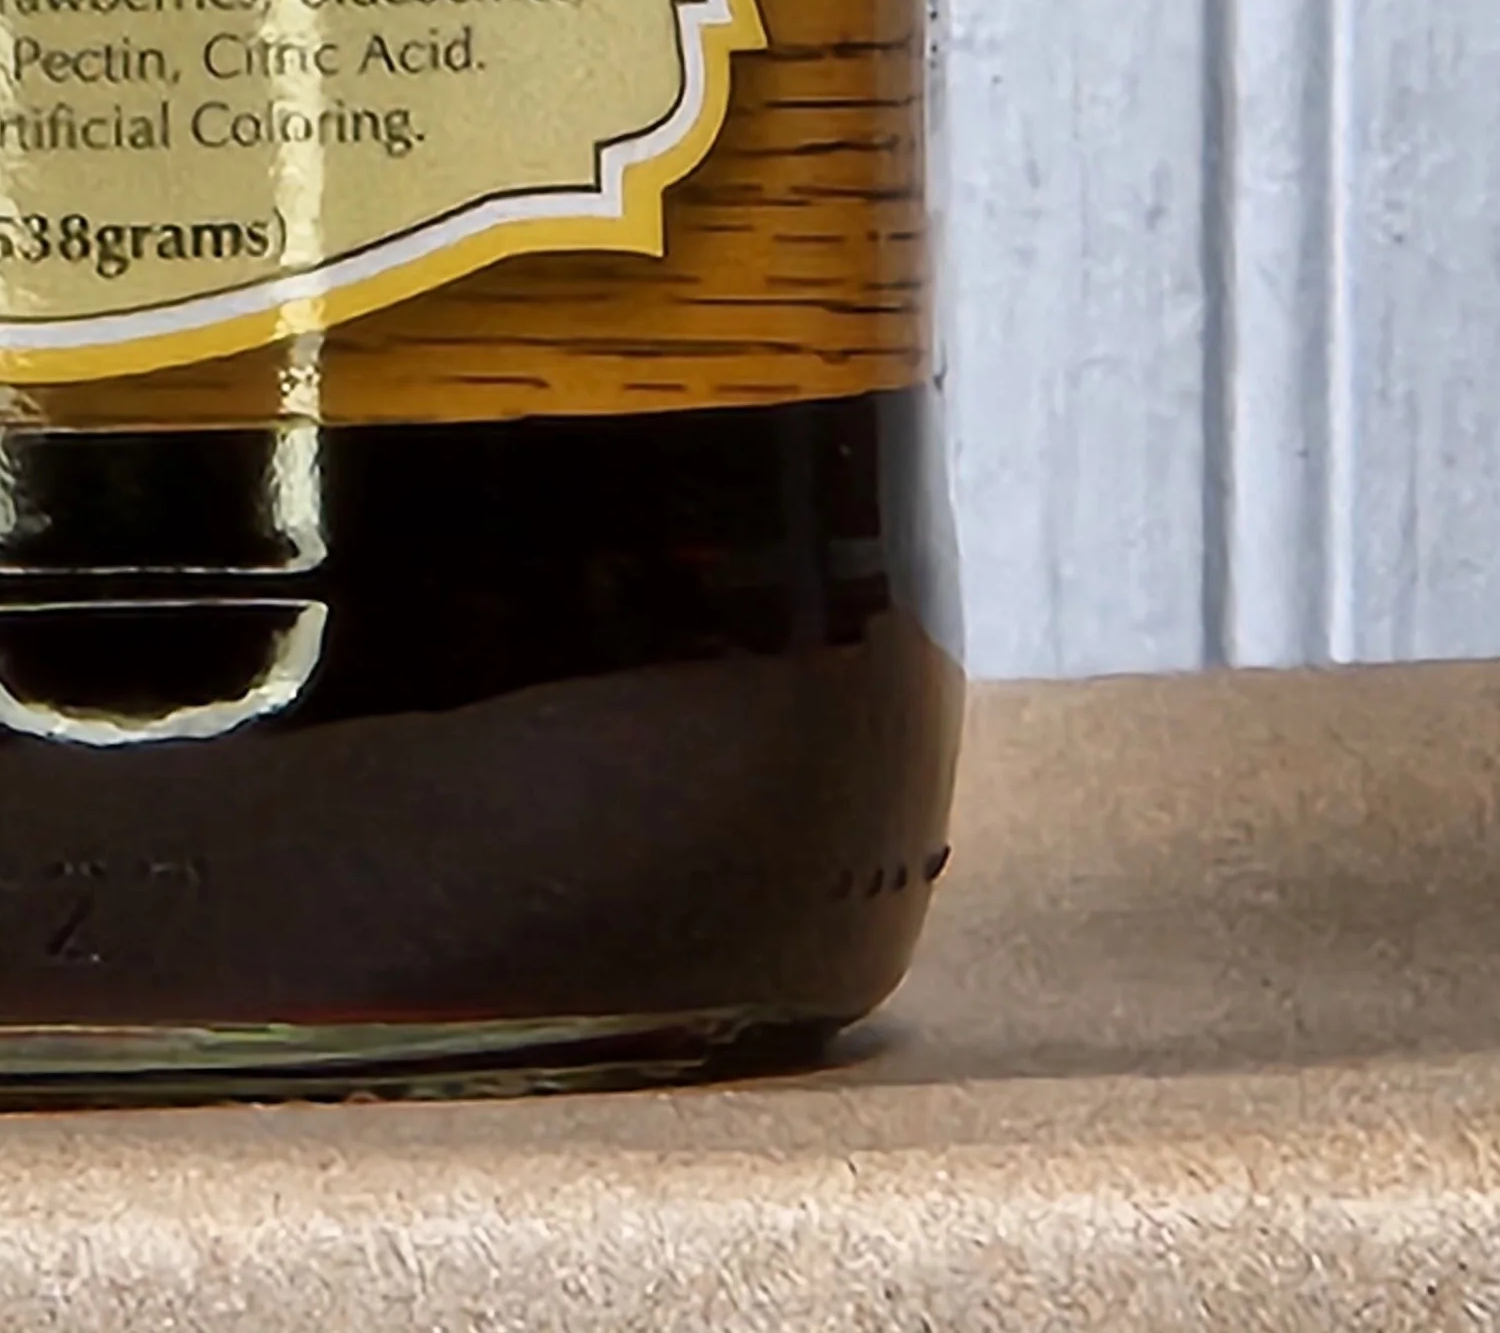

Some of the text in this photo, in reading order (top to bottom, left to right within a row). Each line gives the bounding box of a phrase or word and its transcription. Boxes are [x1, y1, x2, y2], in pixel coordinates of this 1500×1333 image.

[13, 35, 181, 83] Pectin,
[203, 31, 341, 79] Citric
[357, 27, 485, 75] Acid.
[190, 93, 425, 156] Coloring.
